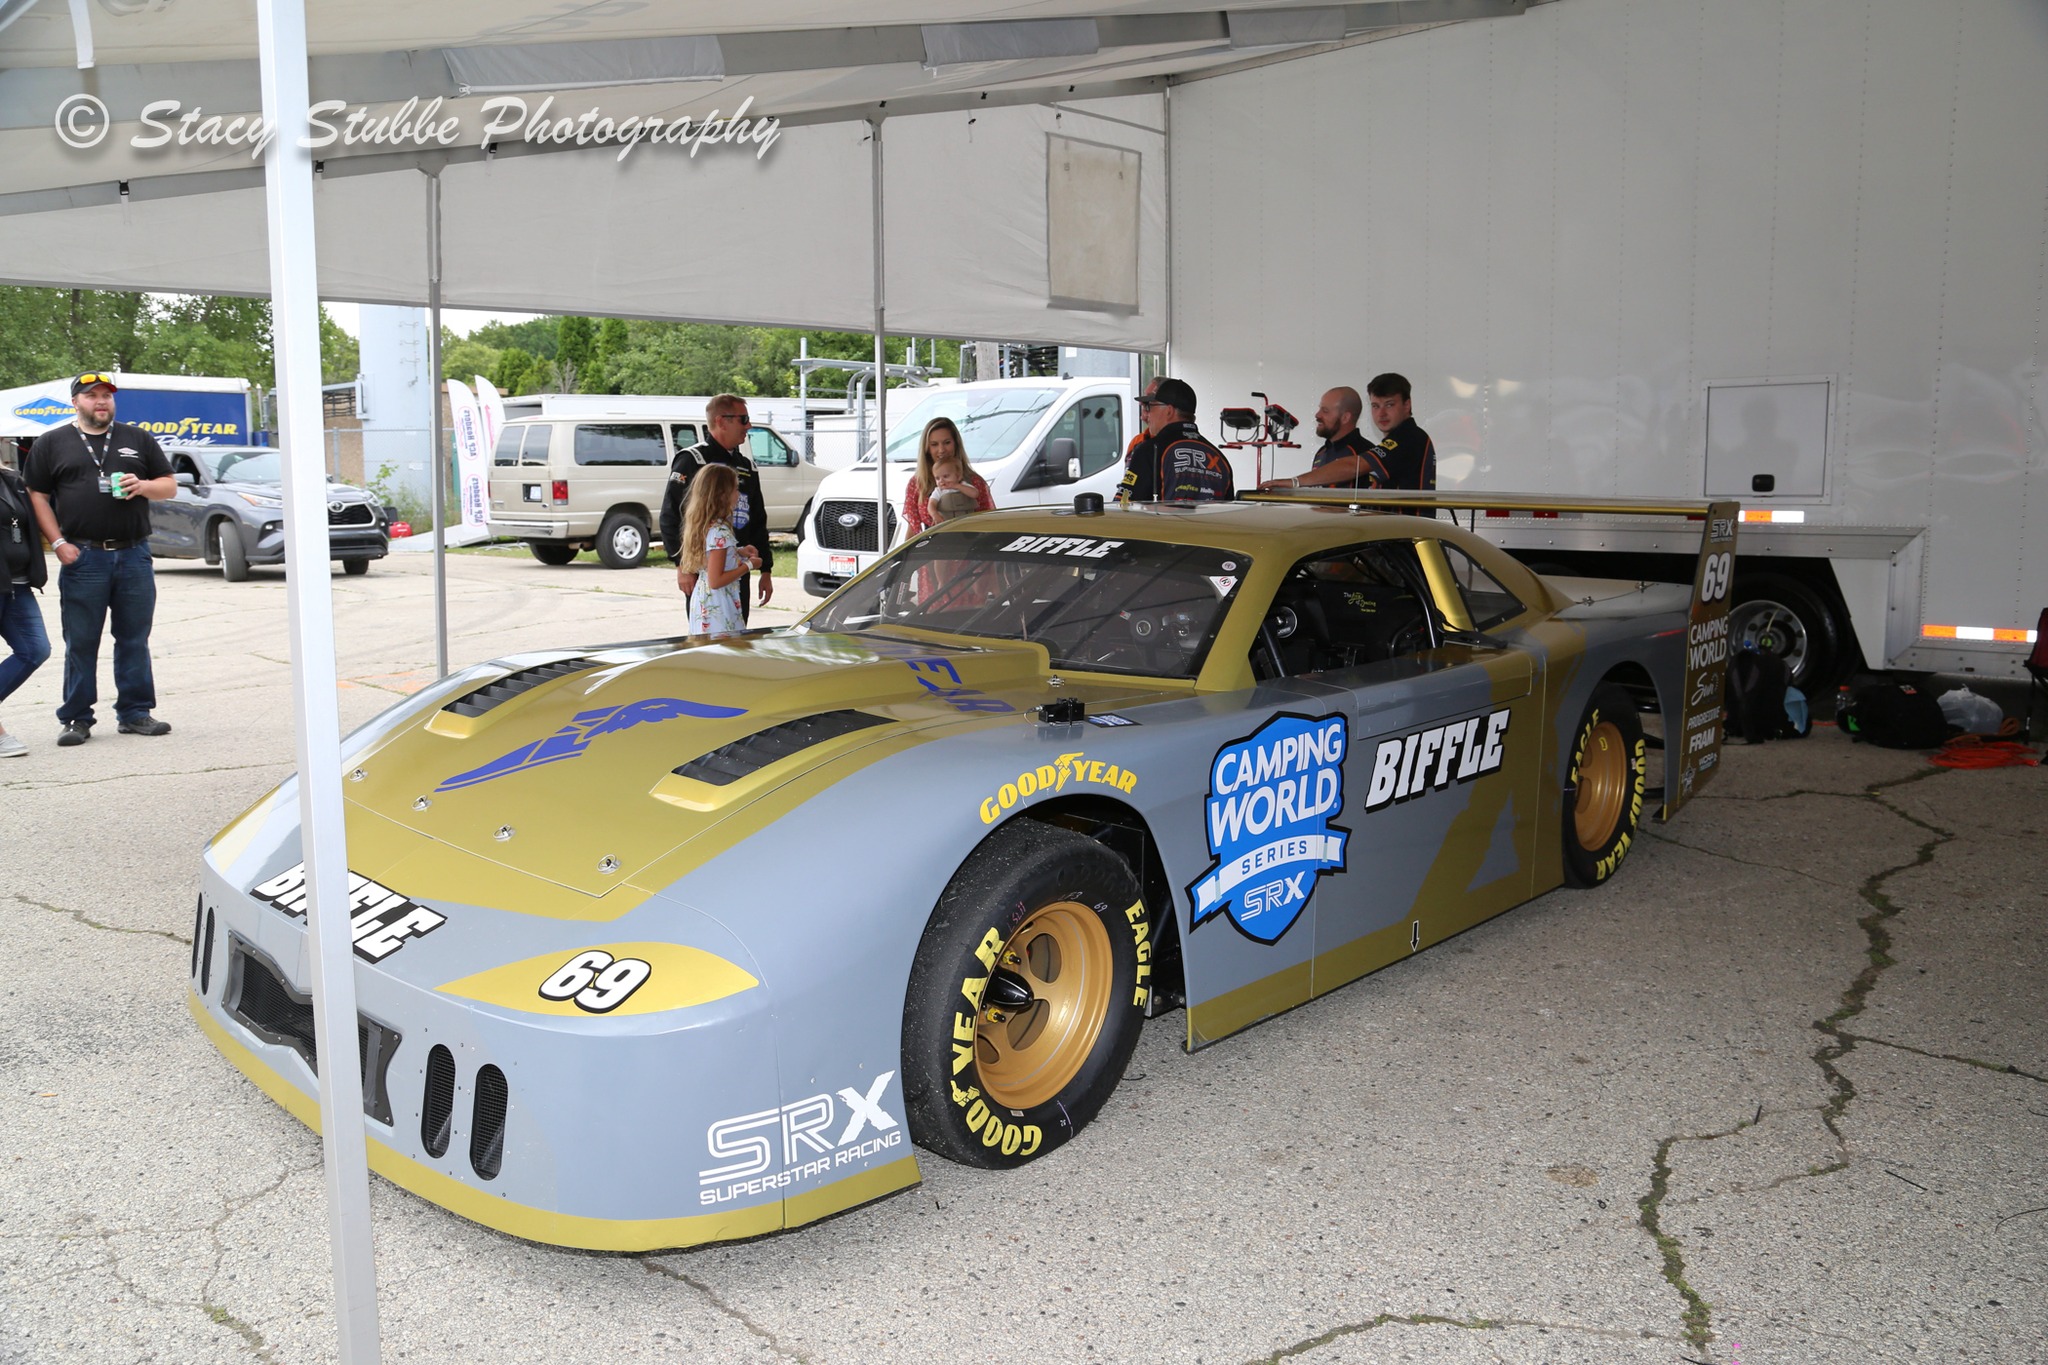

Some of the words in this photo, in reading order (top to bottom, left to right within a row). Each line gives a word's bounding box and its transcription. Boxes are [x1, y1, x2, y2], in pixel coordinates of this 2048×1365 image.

[1174, 448, 1222, 473] SRX
[999, 536, 1125, 558] BIFFLE
[1711, 519, 1733, 538] SRX
[1701, 552, 1731, 602] 69
[1690, 616, 1728, 645] CAMPING
[1690, 638, 1727, 671] WORLD
[1215, 723, 1342, 796] CAMPING
[1365, 709, 1510, 810] BIFFLE
[1689, 727, 1715, 754] FRAM
[1210, 767, 1338, 847] WORLD
[1241, 840, 1308, 874] SERIES
[1240, 871, 1306, 921] SRX
[1125, 899, 1152, 1009] EAGLE
[538, 950, 652, 1014] 69
[699, 1070, 899, 1186] SRX
[700, 1158, 831, 1206] SUPERSTAR
[835, 1130, 902, 1169] RACING
